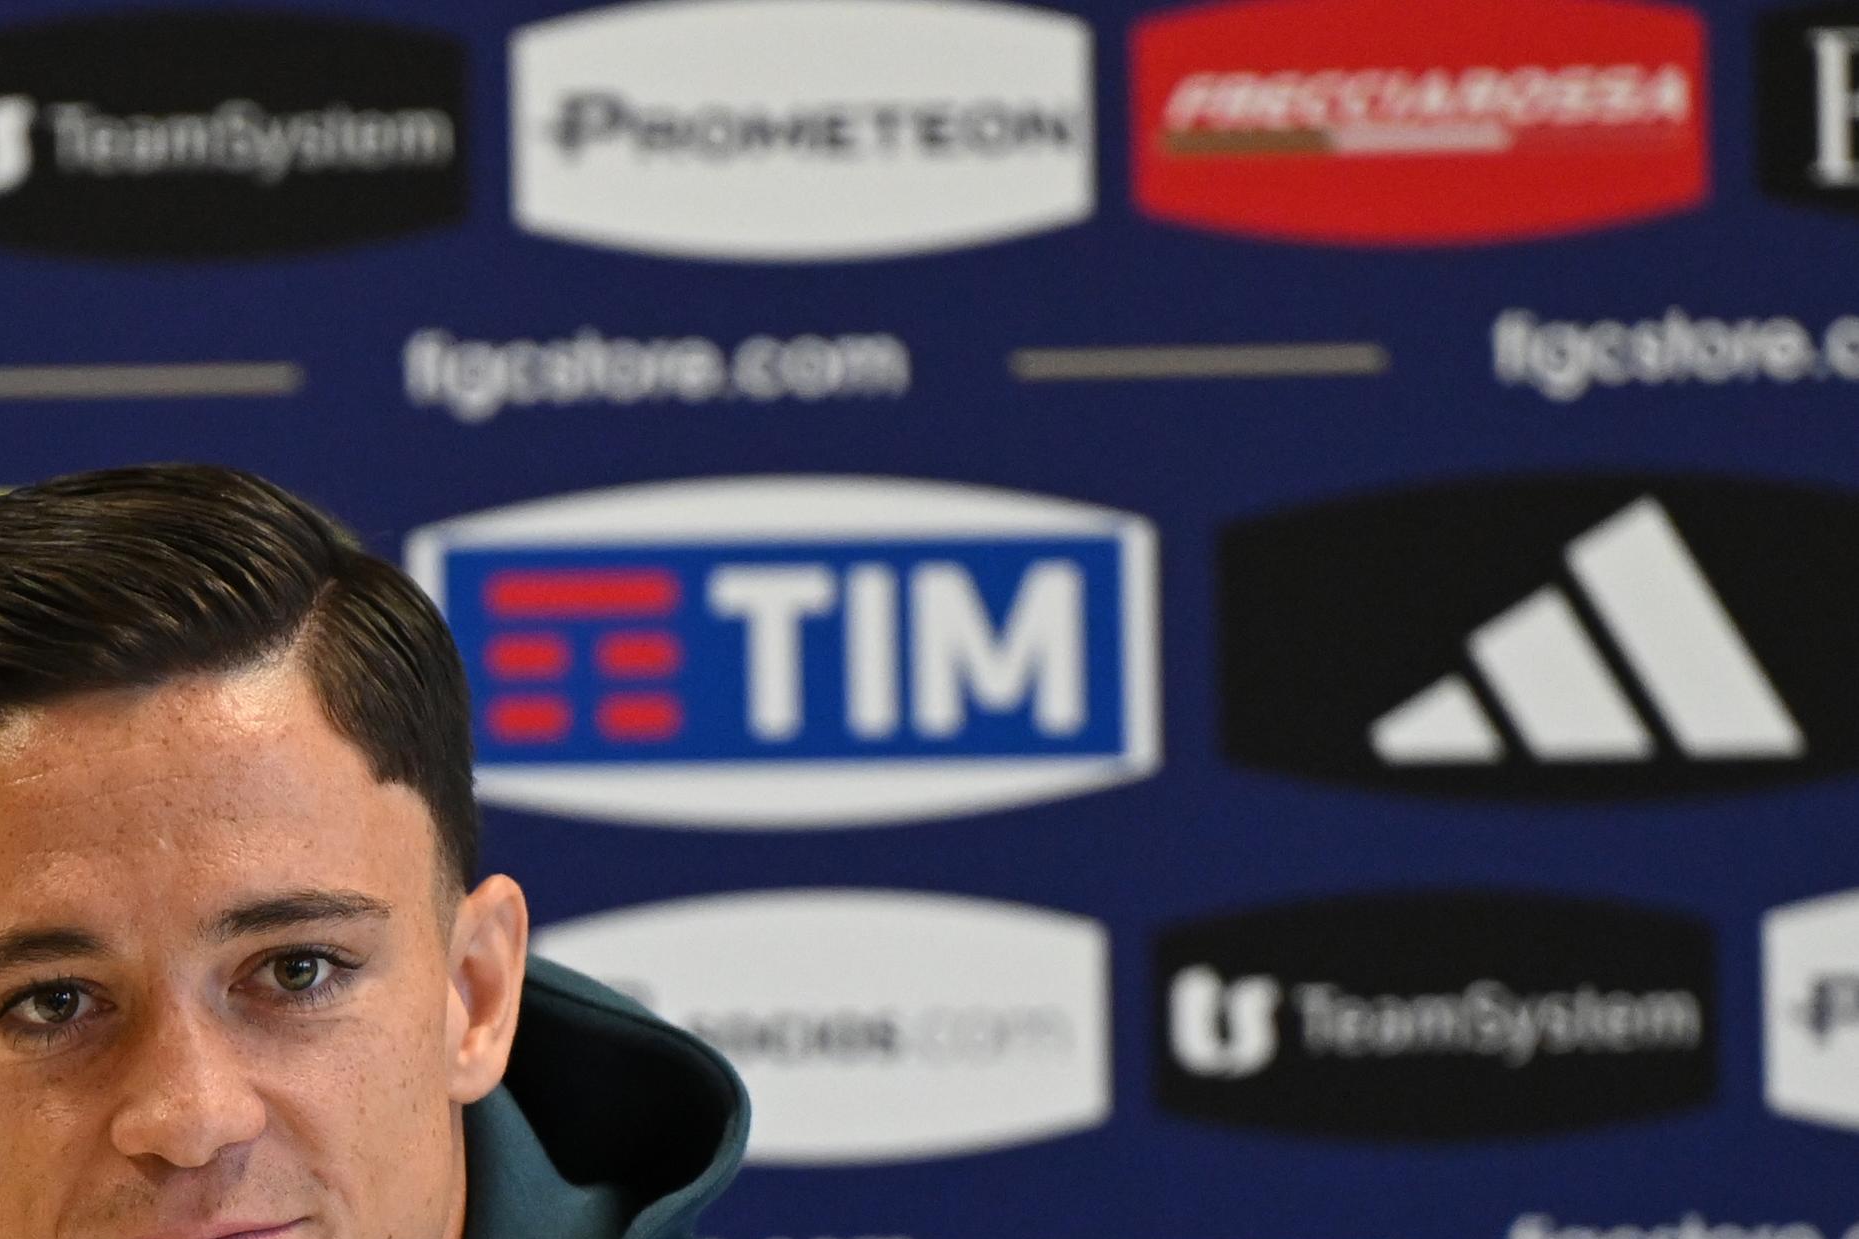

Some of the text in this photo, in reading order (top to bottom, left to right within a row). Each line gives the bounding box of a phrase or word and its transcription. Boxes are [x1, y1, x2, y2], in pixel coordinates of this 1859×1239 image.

[51, 100, 454, 180] TeamSystem
[1163, 66, 1689, 130] FRECCIAROSSA
[404, 330, 910, 420] figcstore.com
[708, 560, 1086, 740] TIM
[1296, 980, 1702, 1064] TeamSystem
